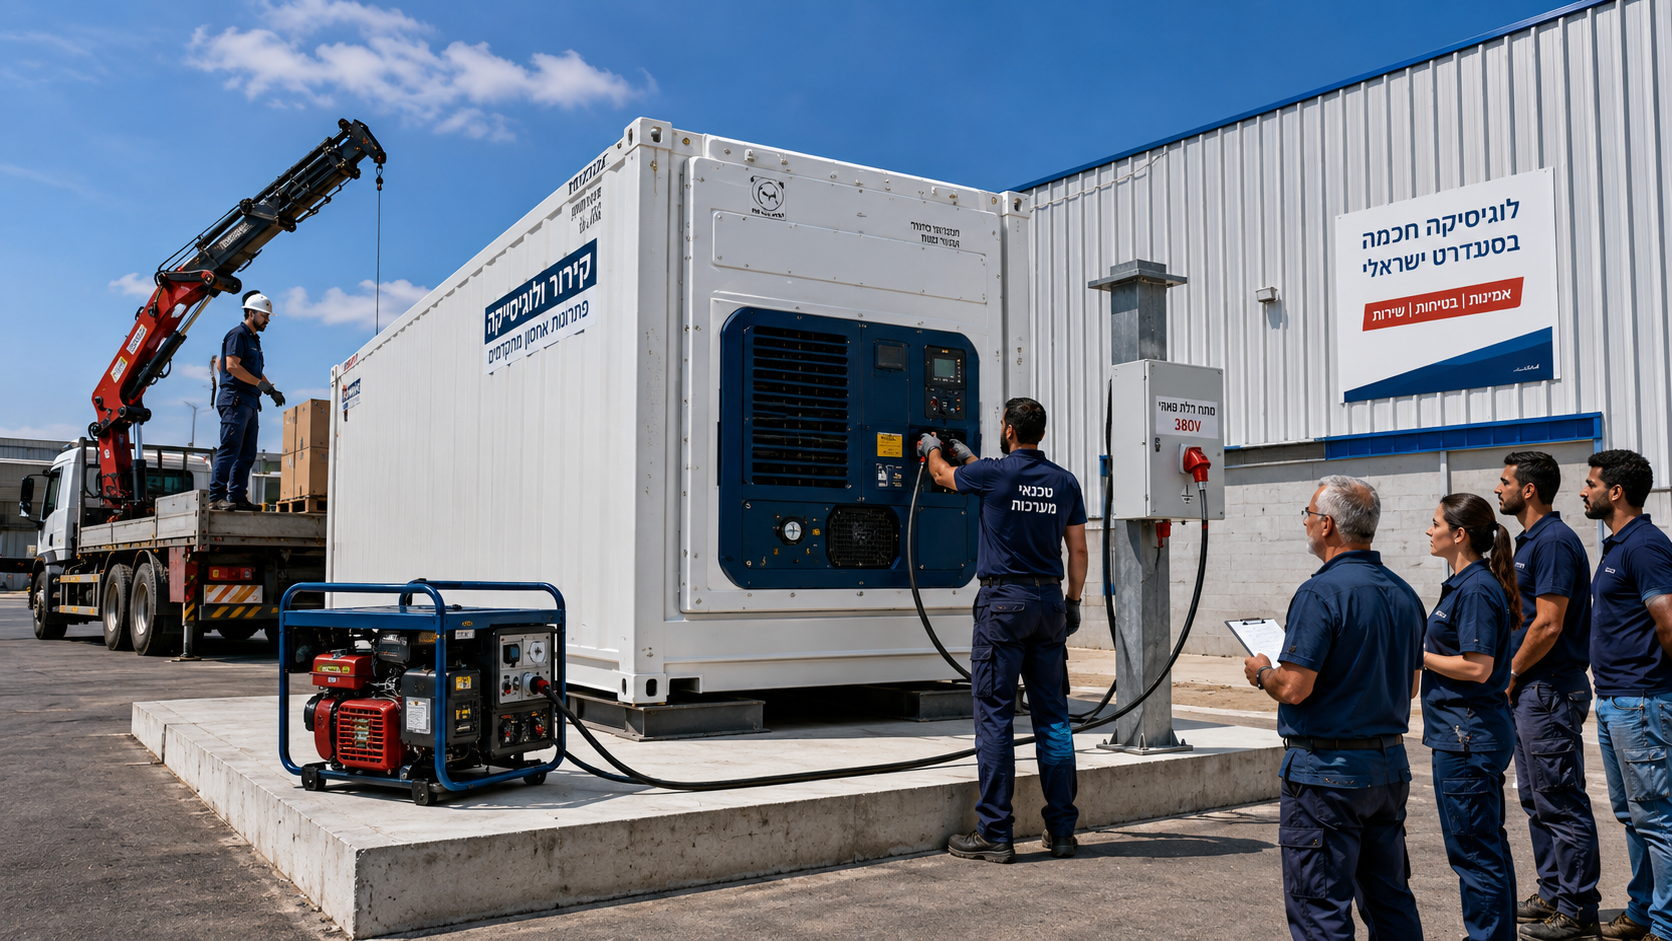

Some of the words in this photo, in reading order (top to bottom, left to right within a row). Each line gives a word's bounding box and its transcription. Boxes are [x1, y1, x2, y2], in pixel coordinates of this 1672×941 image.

[1427, 198, 1519, 237] לוגיסיקה
[1363, 223, 1419, 249] חכמה
[1363, 252, 1425, 278] ישראלי
[549, 252, 591, 297] קירור
[1415, 297, 1458, 315] בטיחות
[1468, 288, 1511, 306] אמינות
[1372, 306, 1405, 322] שירות
[1174, 418, 1201, 432] 380V
[1018, 485, 1053, 498] טכנאי
[1011, 500, 1057, 514] מערכות
